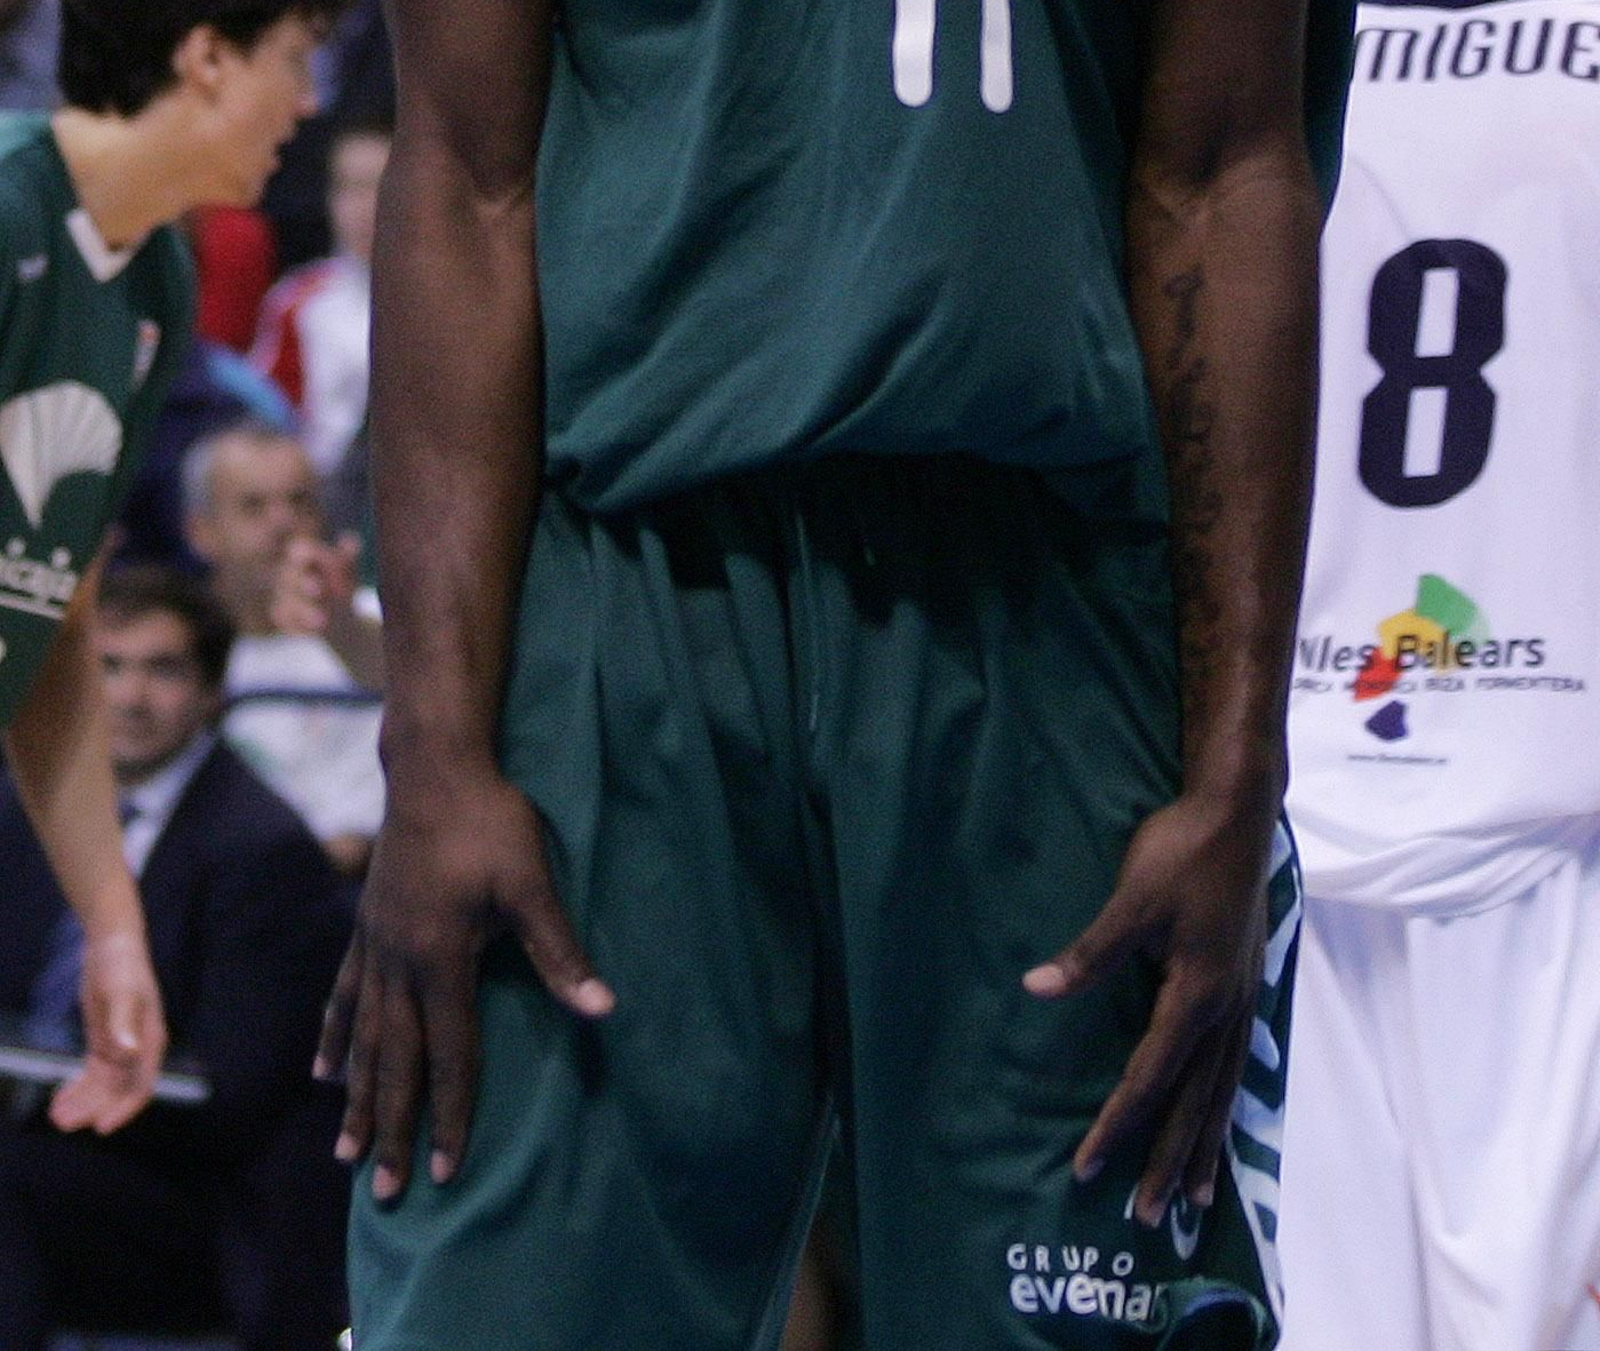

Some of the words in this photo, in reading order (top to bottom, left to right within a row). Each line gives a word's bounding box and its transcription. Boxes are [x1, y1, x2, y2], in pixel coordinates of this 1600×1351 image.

[1355, 18, 1600, 83] MIGUE
[1359, 238, 1508, 509] 8
[1394, 630, 1546, 672] Balears
[1006, 1243, 1134, 1276] GRUPO
